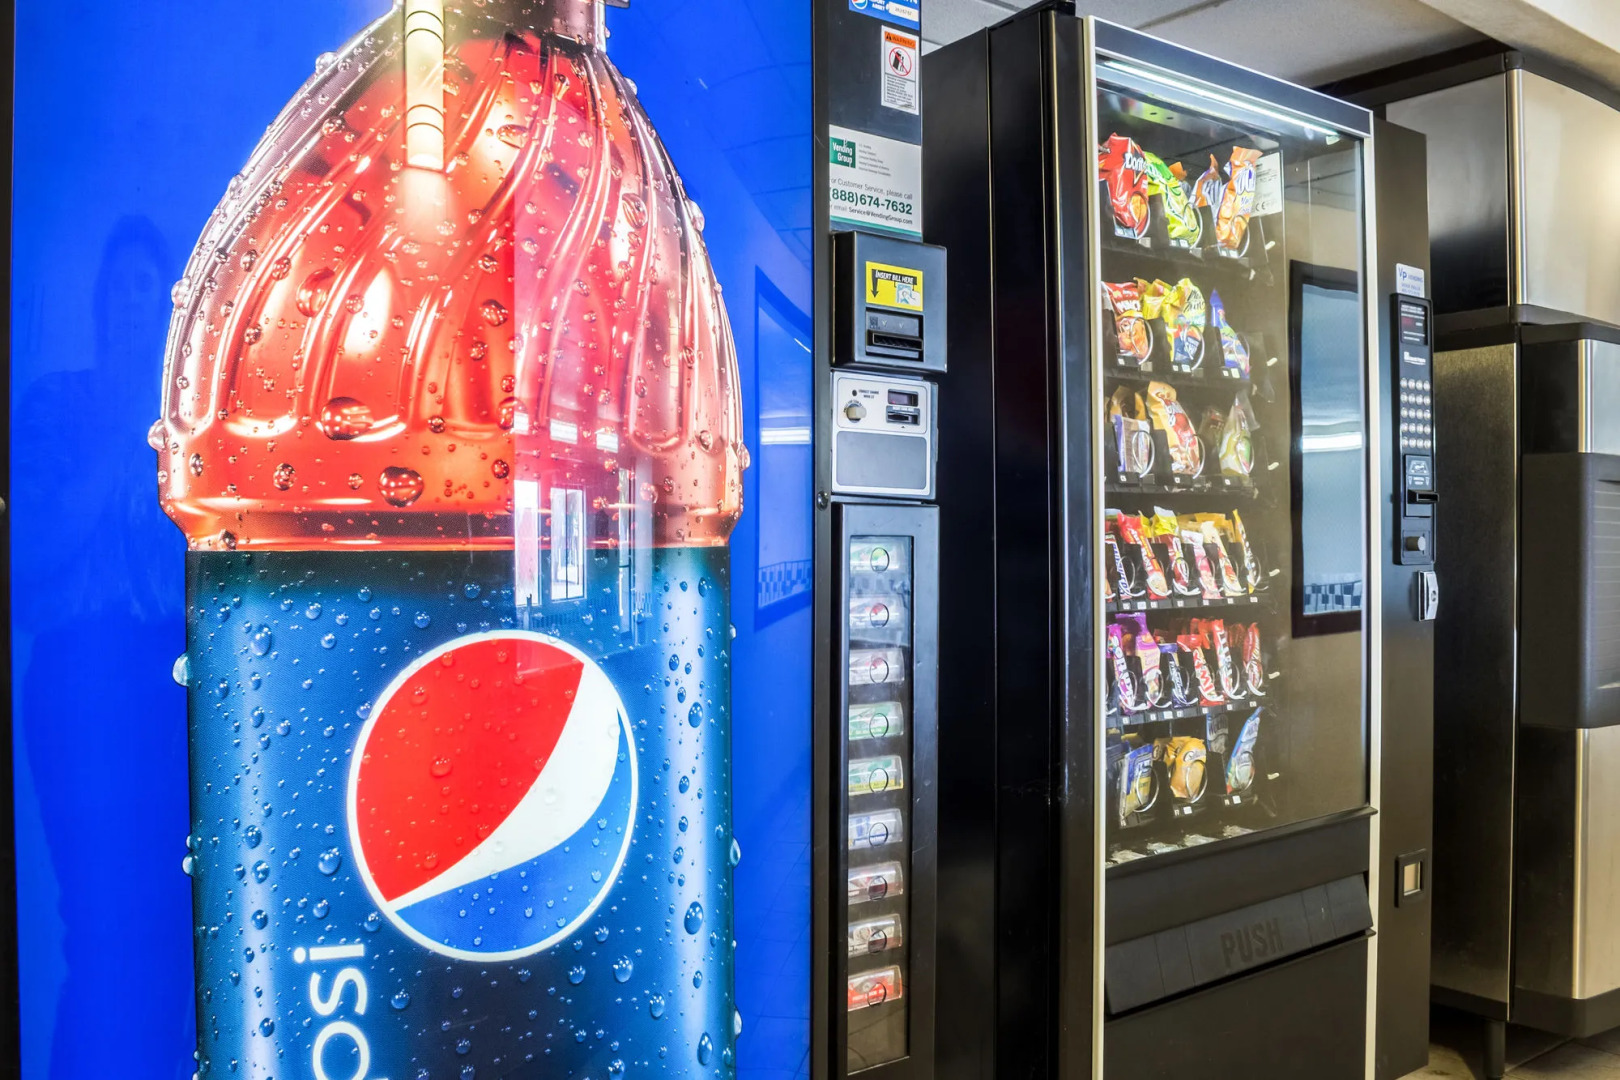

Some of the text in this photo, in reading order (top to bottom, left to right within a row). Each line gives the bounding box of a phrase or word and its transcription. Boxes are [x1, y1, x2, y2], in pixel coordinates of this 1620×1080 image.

[832, 140, 852, 156] Vending
[837, 152, 852, 167] Group
[837, 178, 863, 190] Customer
[886, 189, 903, 199] please
[829, 187, 913, 215] 888)674-7632
[875, 269, 914, 285] INSERT BILL HERE
[1221, 917, 1284, 970] PUSH
